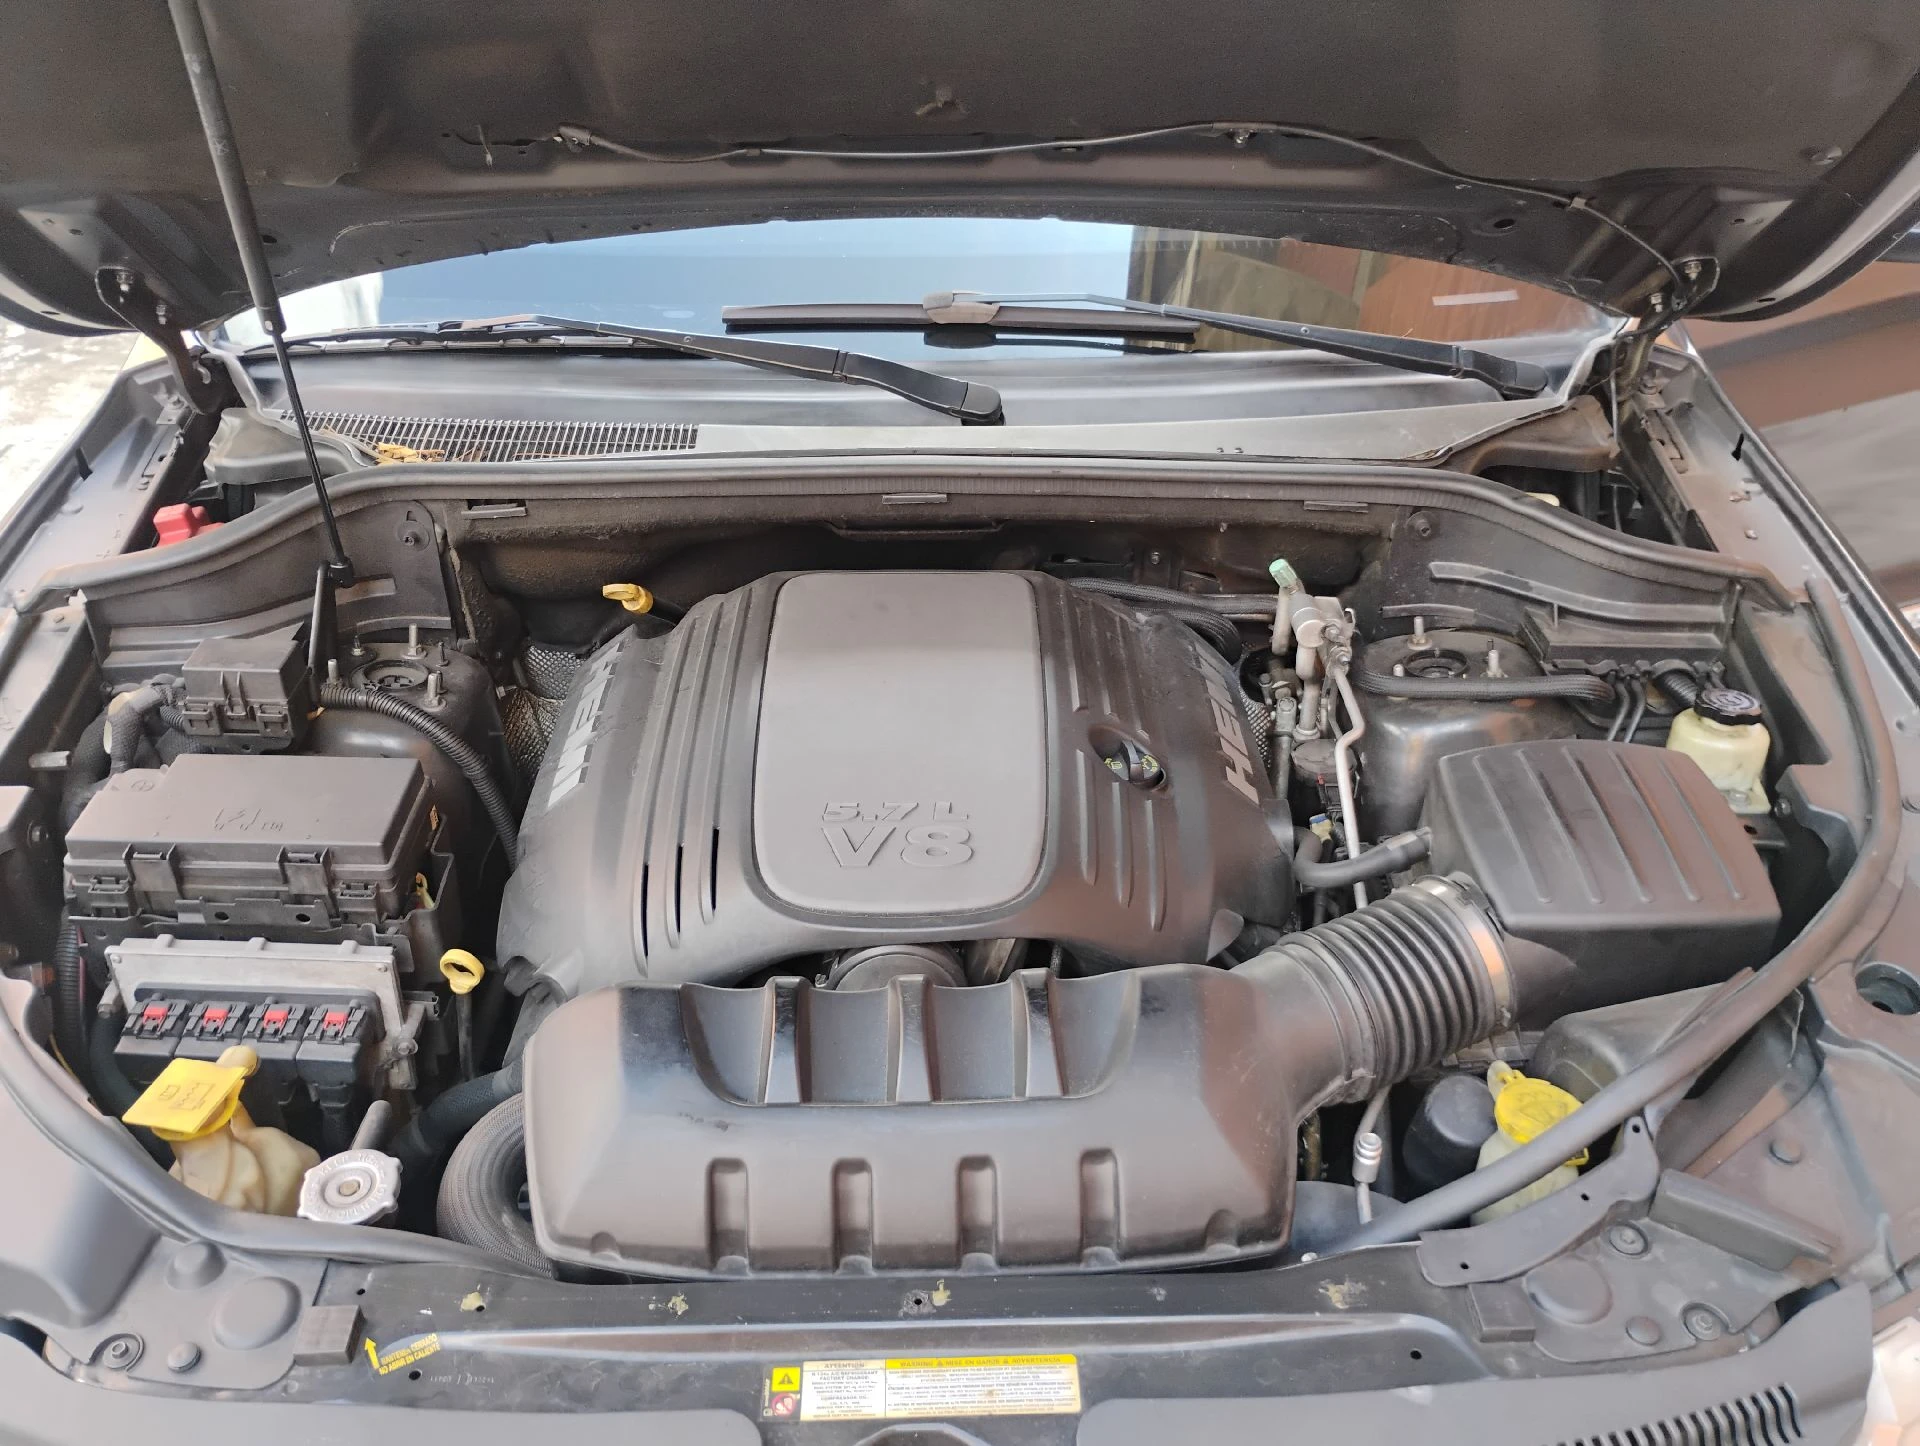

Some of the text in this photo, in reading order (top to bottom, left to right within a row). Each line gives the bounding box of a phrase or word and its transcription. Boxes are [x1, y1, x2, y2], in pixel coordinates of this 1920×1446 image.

[548, 642, 624, 808] HEMI
[1194, 641, 1259, 804] HEMI
[820, 825, 976, 868] V8
[379, 1365, 388, 1376] NO
[388, 1358, 407, 1372] ABRIR
[406, 1354, 415, 1365] EN
